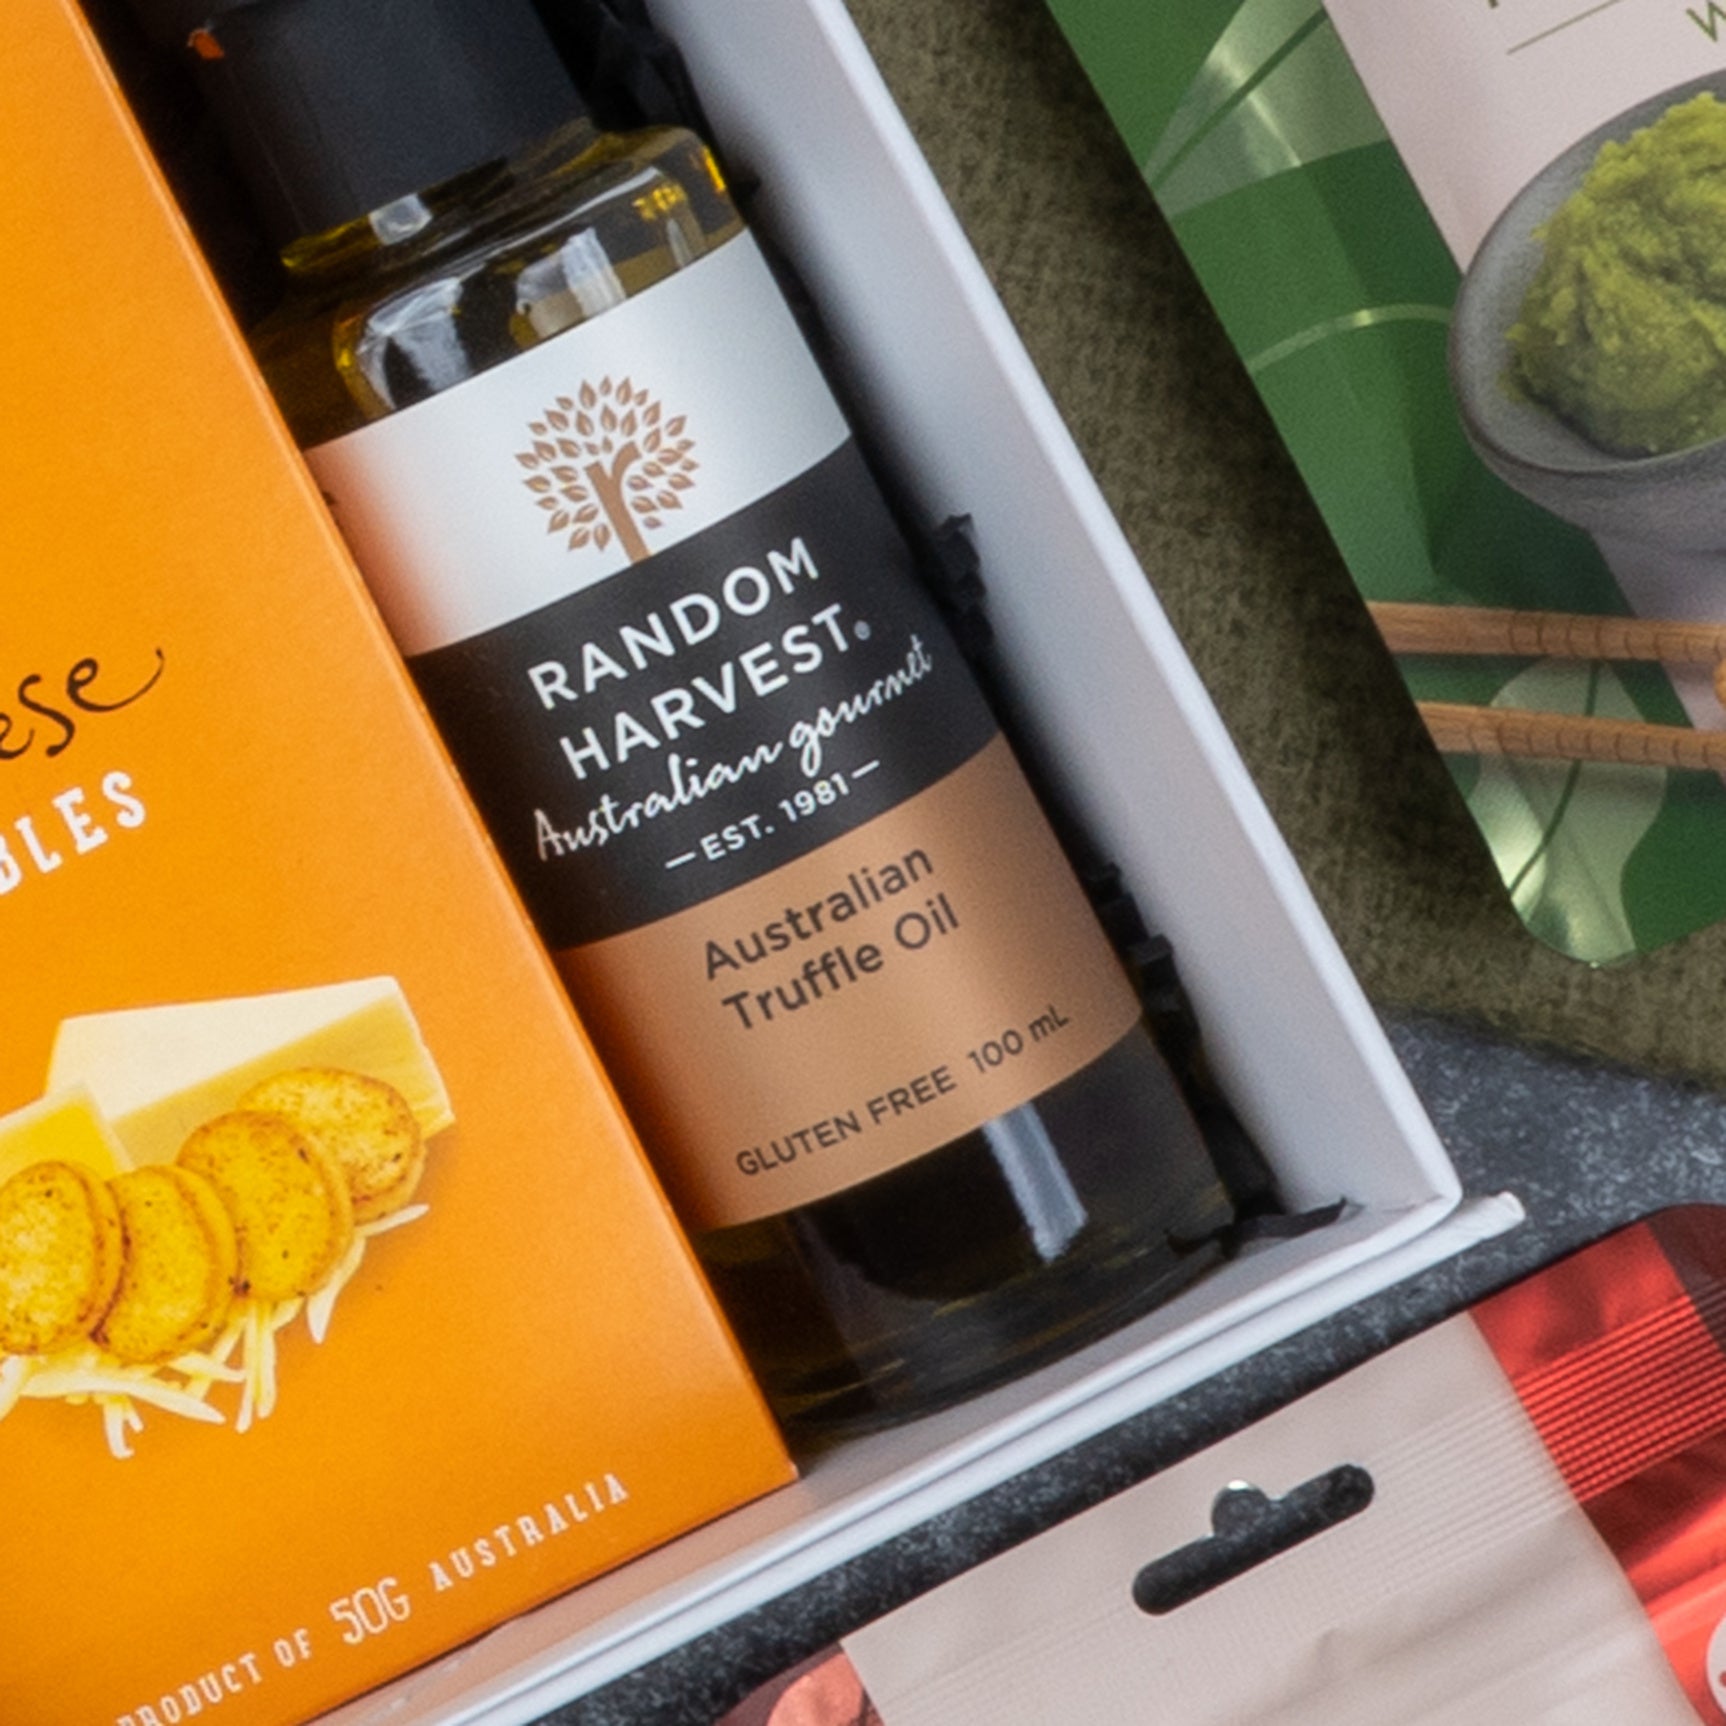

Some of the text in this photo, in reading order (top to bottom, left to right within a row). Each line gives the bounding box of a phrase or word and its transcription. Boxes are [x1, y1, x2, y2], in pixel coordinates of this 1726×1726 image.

[528, 536, 820, 710] RANDOM
[560, 603, 850, 780] HARVEST
[533, 633, 933, 862] Australian gourmet
[779, 772, 851, 822] 1981
[704, 848, 934, 981] Australian
[721, 892, 961, 1030] Truffle Oil
[735, 1004, 1070, 1176] GLUTEN FREE 100 mL
[273, 1627, 312, 1668] OF
[328, 1576, 412, 1646] 50G
[428, 1472, 630, 1592] AUSTRALIA
